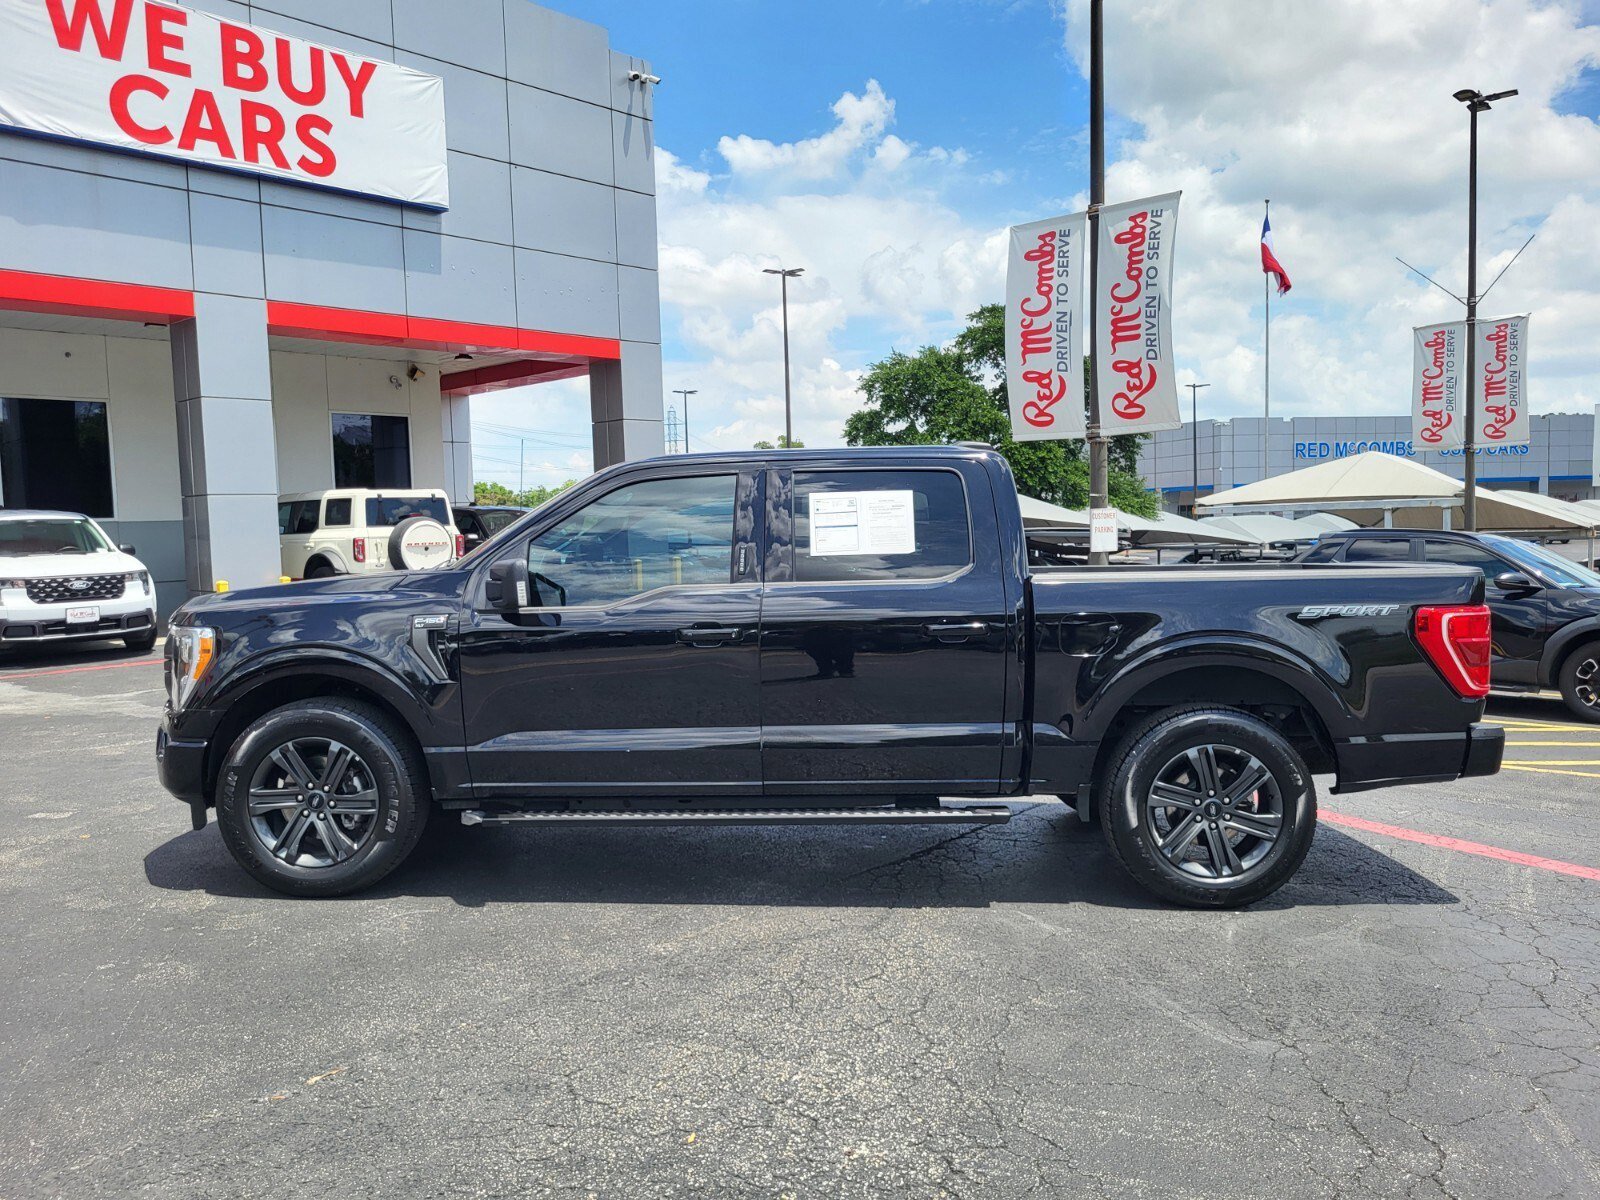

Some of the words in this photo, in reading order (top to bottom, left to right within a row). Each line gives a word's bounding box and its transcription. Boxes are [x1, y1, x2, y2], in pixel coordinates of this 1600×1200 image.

[45, 0, 192, 78] WE
[220, 22, 377, 118] BUY
[109, 74, 337, 178] CARS
[1147, 208, 1163, 261] SERVE
[1057, 228, 1071, 278] SERVE
[1056, 282, 1069, 307] TO
[1110, 211, 1149, 355] McCombs
[1145, 265, 1158, 290] TO
[1020, 230, 1057, 366] McCombs
[1056, 312, 1069, 373] DRIVEN
[1145, 295, 1158, 361] DRIVEN
[1446, 328, 1456, 358] SERVE
[1509, 321, 1519, 352] SERVE
[1421, 329, 1446, 407] McCombs
[1445, 360, 1455, 375] TO
[1483, 322, 1509, 403] McCombs
[1509, 353, 1519, 369] TO
[1022, 368, 1067, 428] Red
[1111, 357, 1157, 420] Red
[1445, 376, 1455, 412] DRIVEN
[1508, 370, 1518, 407] DRIVEN
[1420, 409, 1453, 443] Red
[1482, 404, 1516, 440] Red
[1294, 442, 1331, 458] RED
[1091, 512, 1117, 520] CUSTOMER
[1094, 525, 1114, 534] PARKING
[1296, 604, 1400, 619] SPORT
